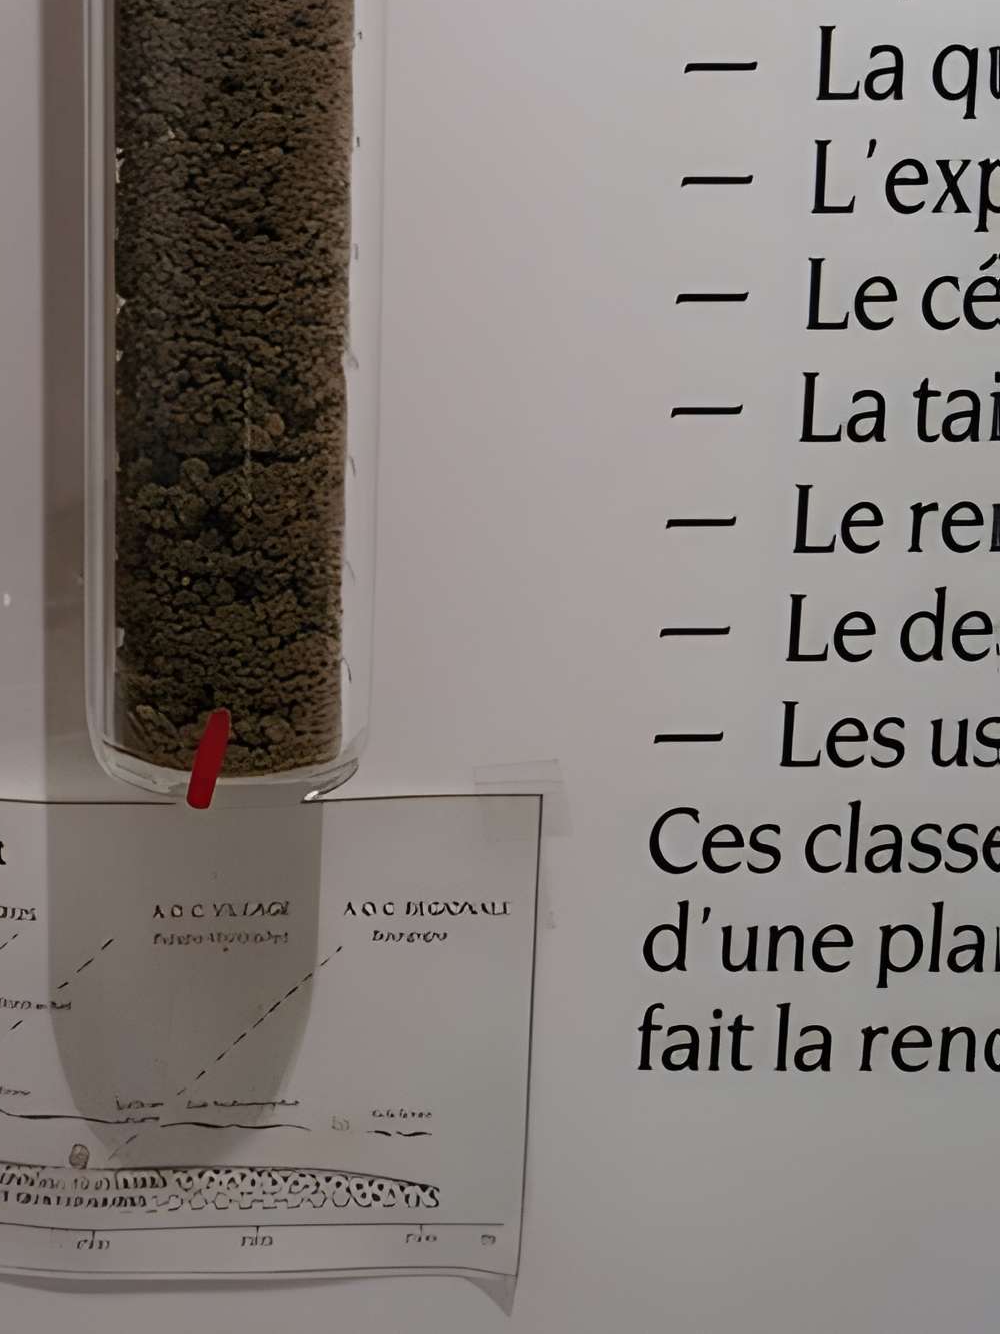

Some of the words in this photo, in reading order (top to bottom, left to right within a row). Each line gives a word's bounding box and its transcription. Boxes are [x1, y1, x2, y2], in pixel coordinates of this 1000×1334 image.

[816, 25, 904, 101] La
[932, 44, 1000, 120] q
[806, 257, 898, 331] Le
[922, 253, 1000, 331] cé
[799, 372, 887, 443] La
[793, 484, 884, 554] Le
[907, 501, 1000, 554] re
[785, 594, 876, 662] Le
[900, 586, 1000, 663] de
[779, 701, 905, 768] Les
[649, 807, 781, 874] Ces
[643, 900, 854, 973] d'une
[876, 901, 1000, 988] pla
[637, 1002, 755, 1072] fait
[774, 1002, 832, 1072] la
